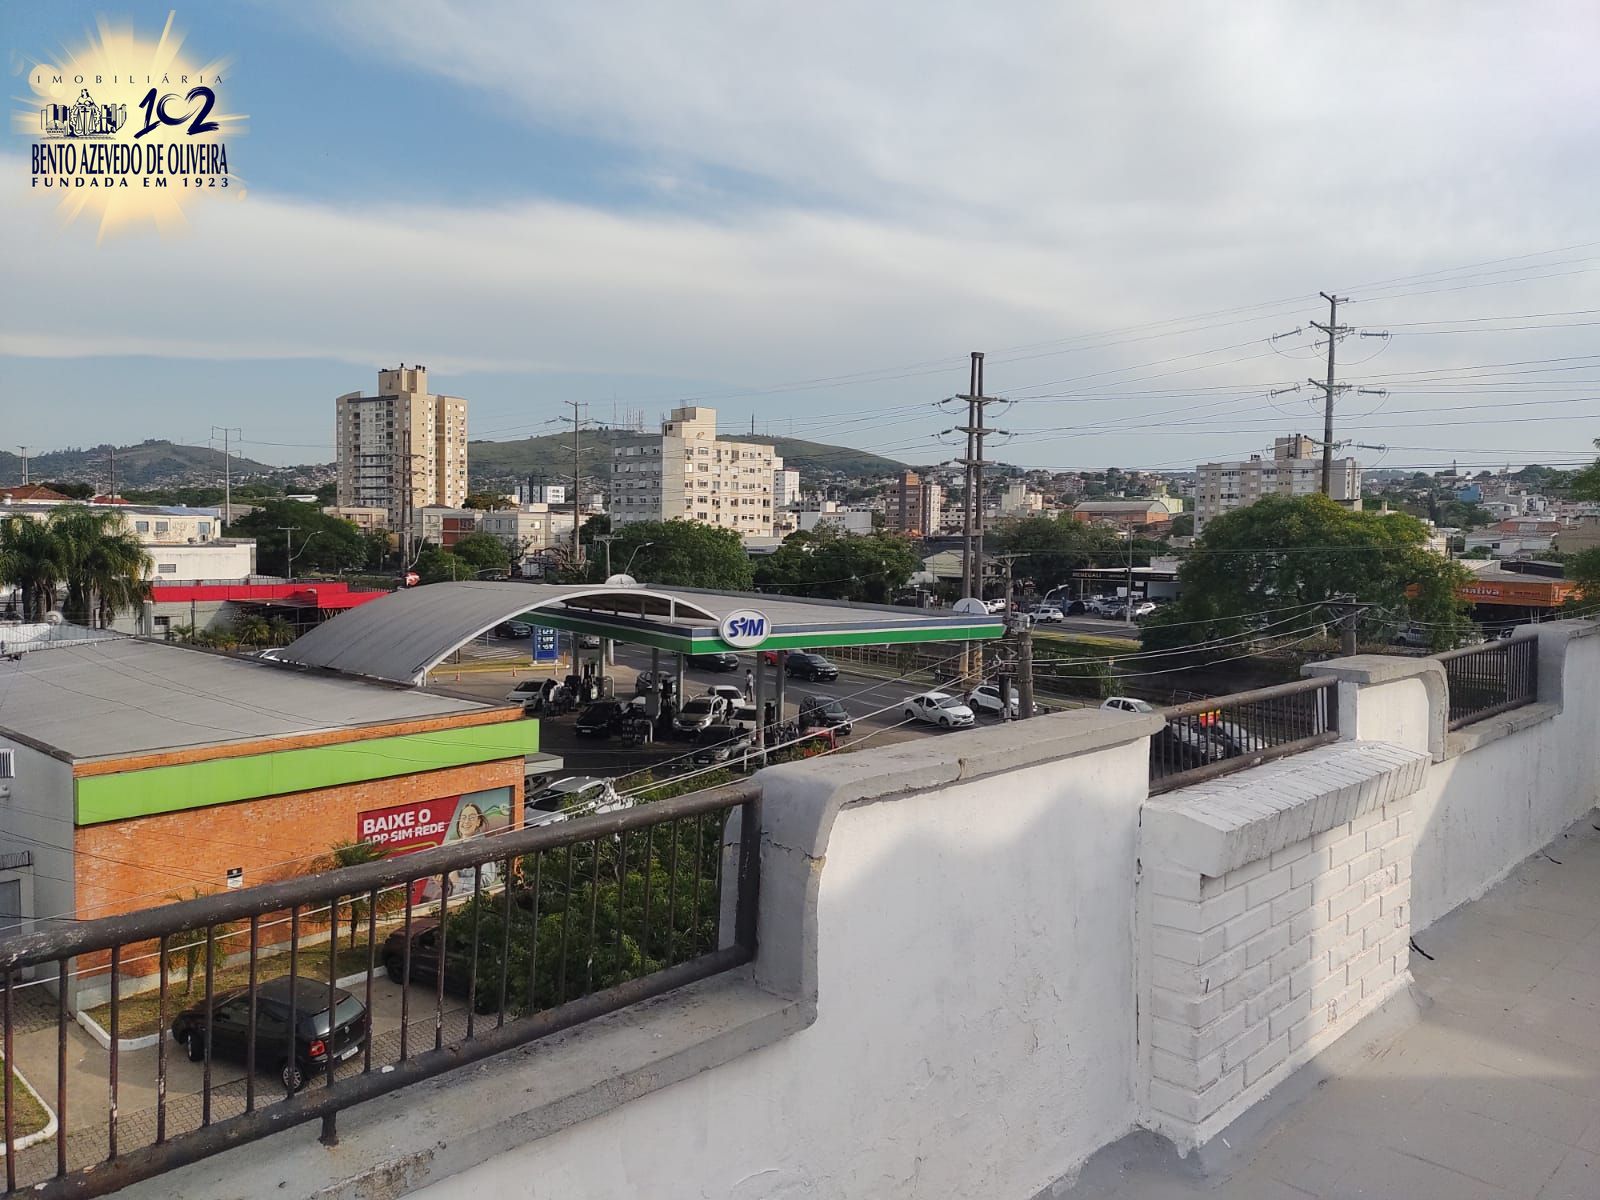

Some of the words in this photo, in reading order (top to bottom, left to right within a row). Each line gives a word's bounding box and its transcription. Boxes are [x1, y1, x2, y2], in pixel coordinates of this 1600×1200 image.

[729, 616, 765, 638] SIM
[363, 811, 415, 835] BAIXE
[418, 808, 432, 823] O
[364, 833, 389, 847] APP
[390, 827, 413, 843] SIM
[415, 821, 445, 837] REDE
